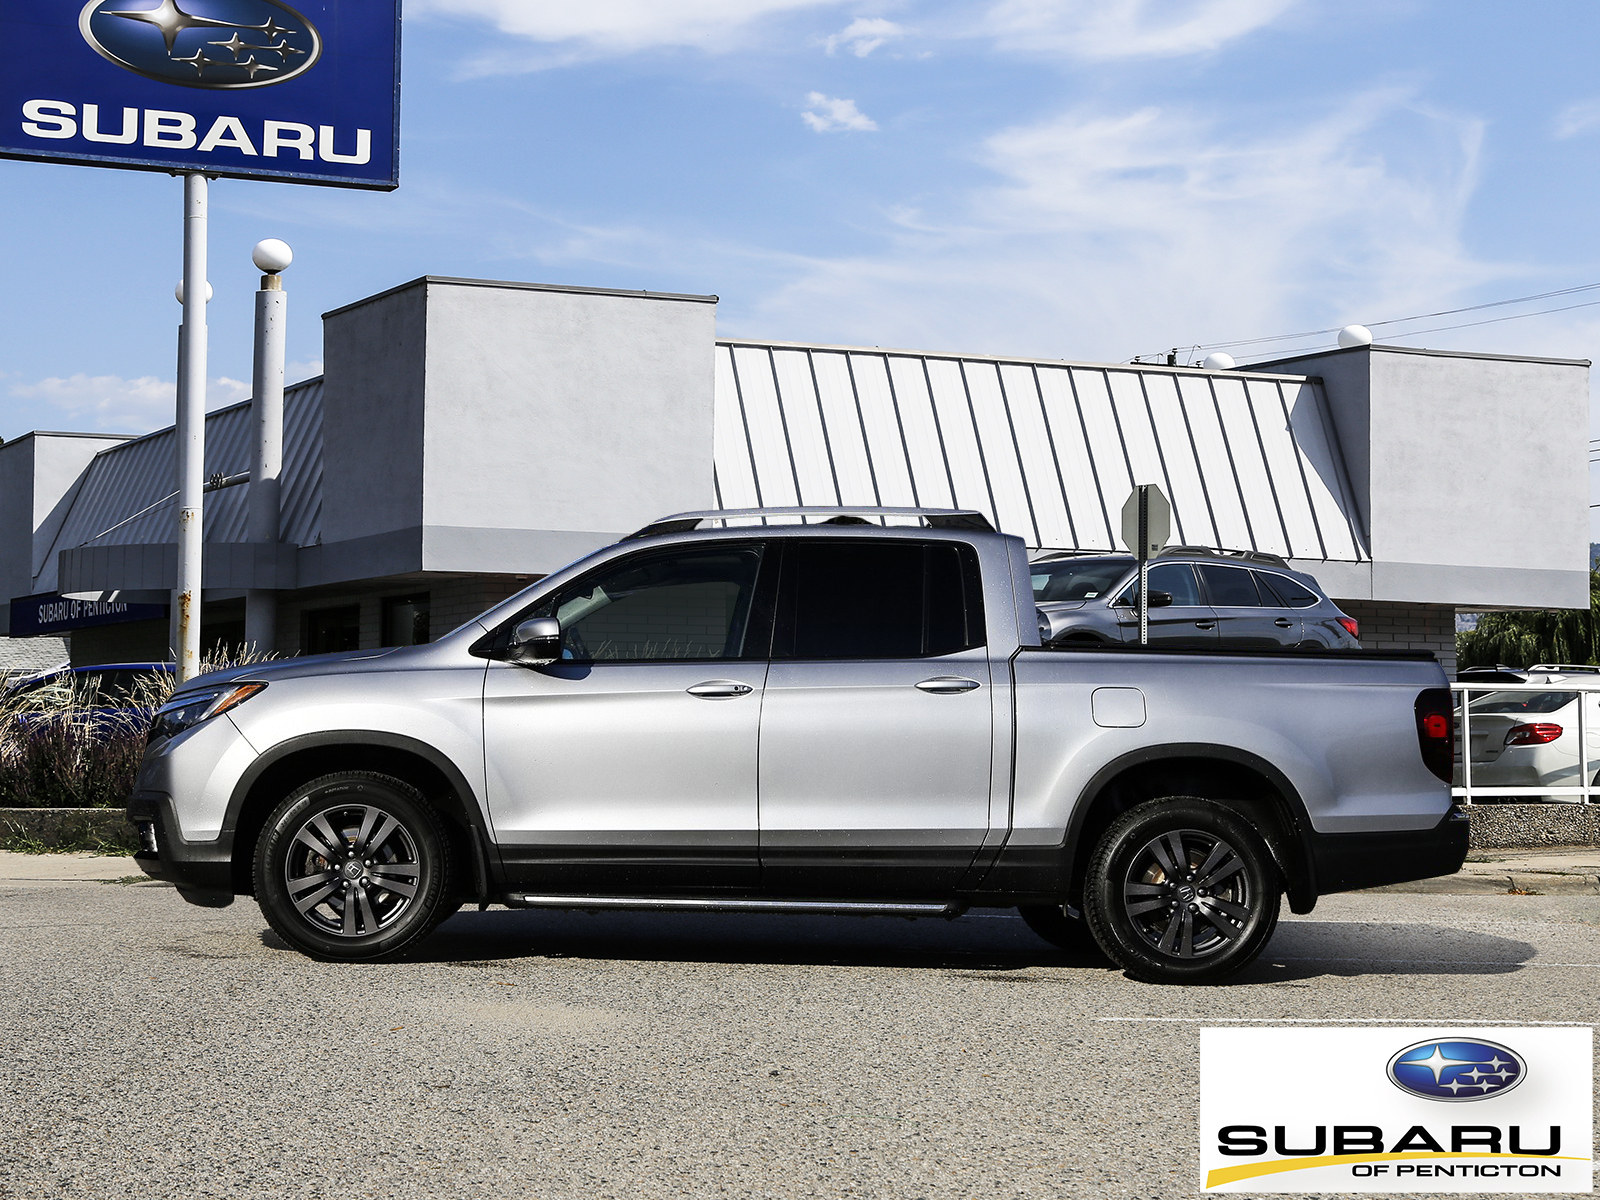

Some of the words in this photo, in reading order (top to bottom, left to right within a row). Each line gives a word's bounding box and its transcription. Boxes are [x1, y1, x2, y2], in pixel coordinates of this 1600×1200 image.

[21, 98, 372, 165] SUBARU
[38, 600, 69, 624] SUBARU
[70, 600, 82, 619] OF
